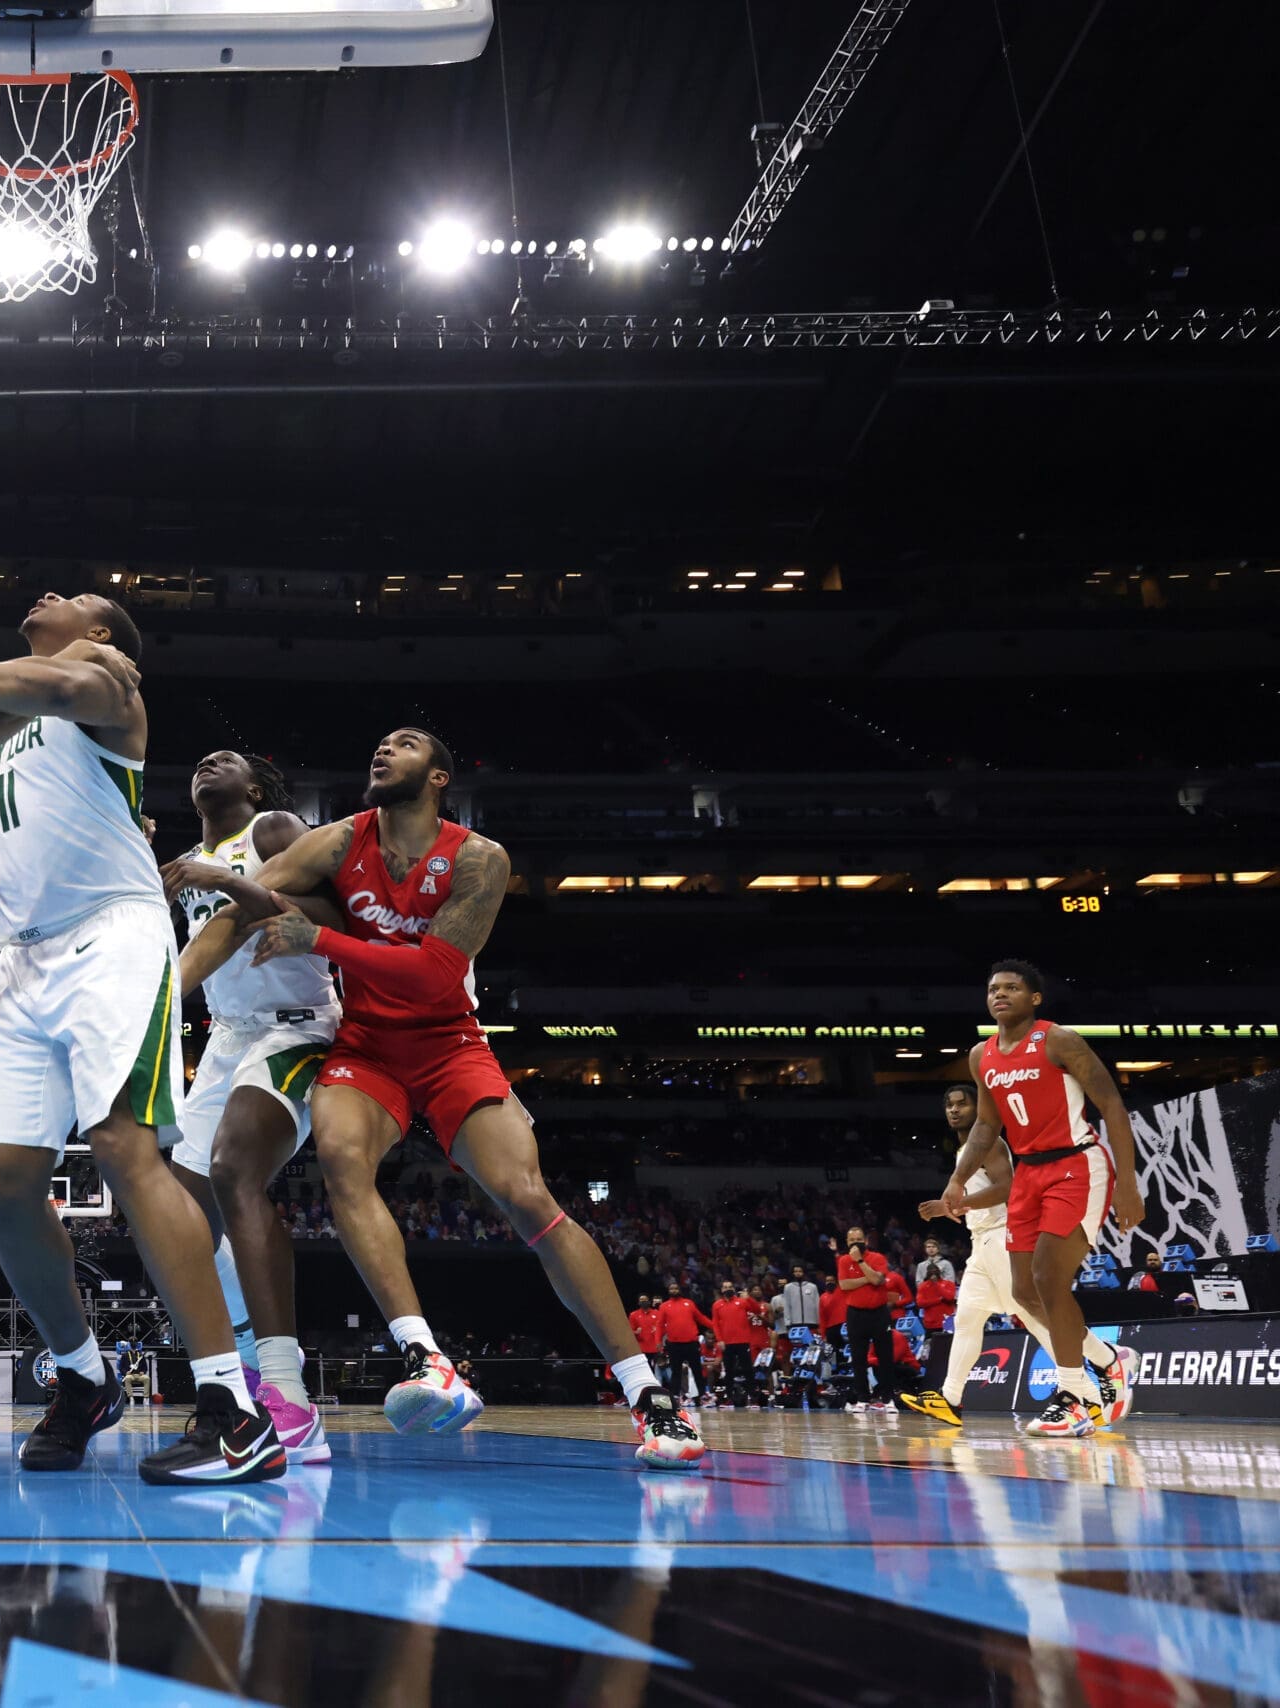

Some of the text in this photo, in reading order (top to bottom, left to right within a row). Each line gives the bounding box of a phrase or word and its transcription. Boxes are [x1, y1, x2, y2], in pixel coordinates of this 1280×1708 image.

[1062, 896, 1100, 912] 6:38
[697, 1026, 925, 1037] HOUSTON COUGARS
[984, 1067, 1040, 1089] Cougars
[1007, 1093, 1029, 1126] 0
[1129, 1349, 1280, 1385] ELEBRATES
